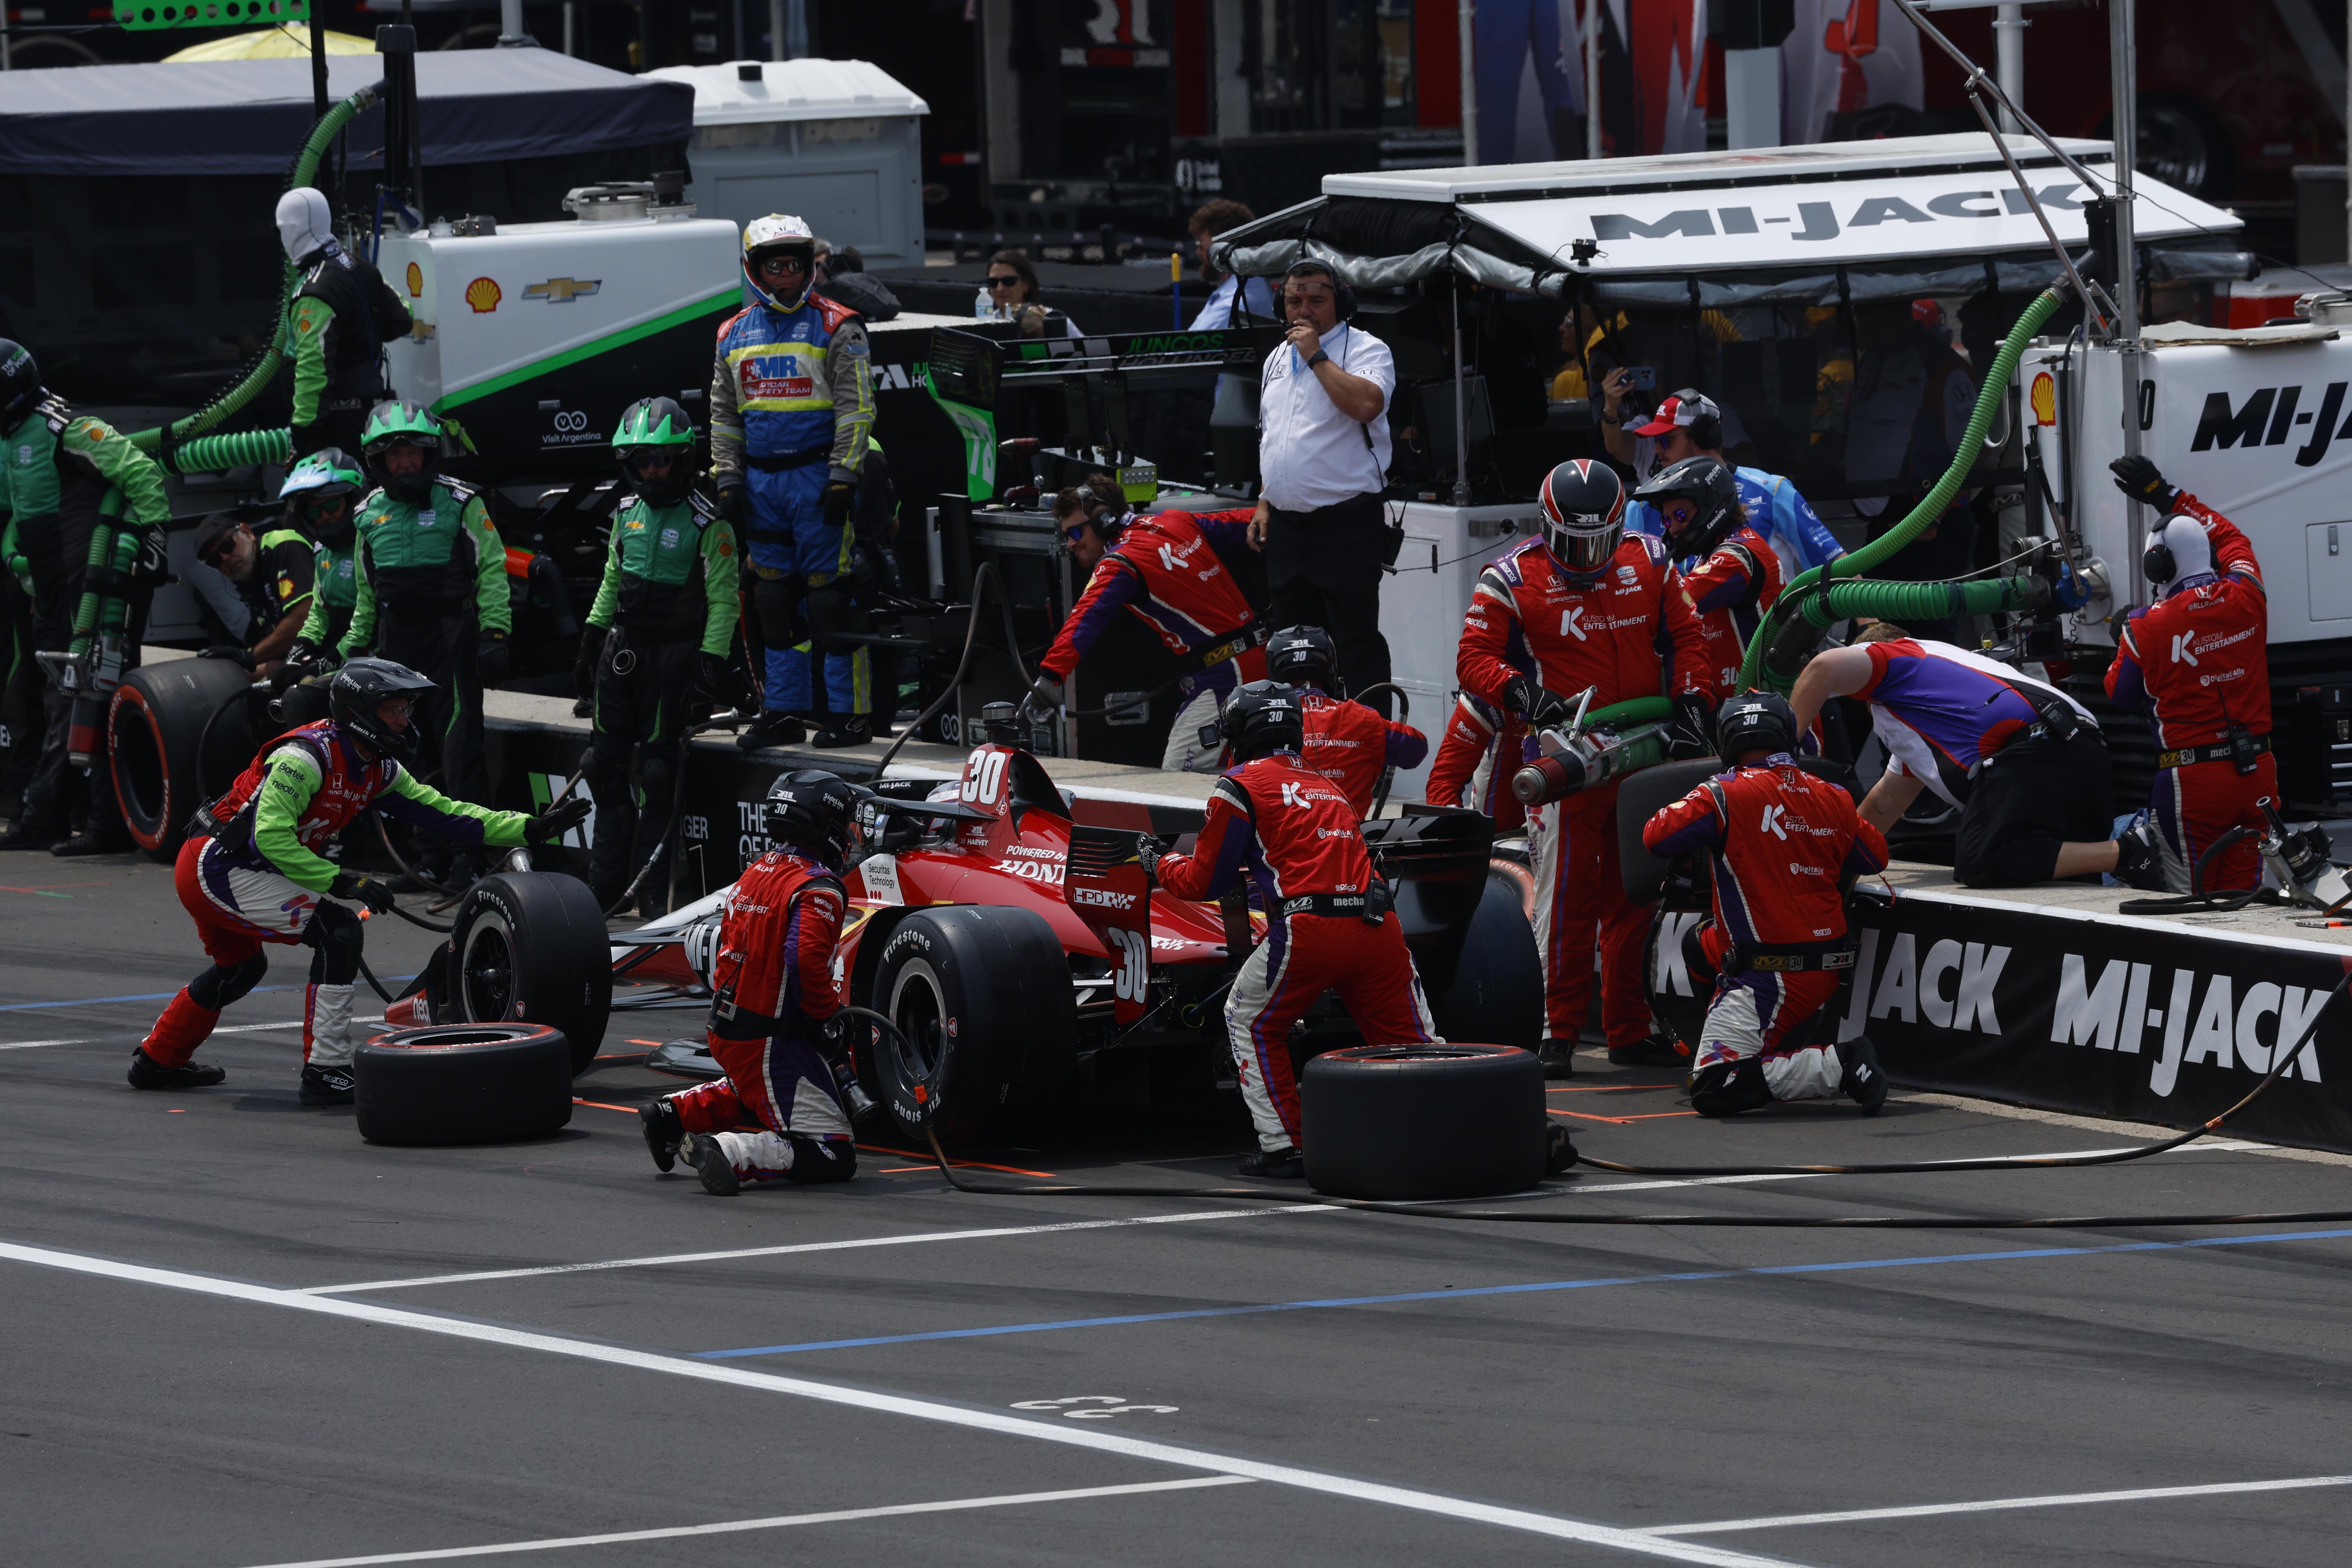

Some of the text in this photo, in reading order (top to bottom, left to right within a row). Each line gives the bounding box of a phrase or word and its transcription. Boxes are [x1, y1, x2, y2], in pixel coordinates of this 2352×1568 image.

[1590, 183, 2086, 241] MI-JACK
[1125, 334, 1224, 354] JUNCOS
[741, 356, 799, 382] AMR
[542, 434, 560, 444] Visit
[1704, 465, 1721, 483] SideLine
[1706, 508, 1727, 530] Connelly
[1499, 562, 1517, 582] sparco
[1615, 585, 1642, 595] MI-JACK
[1552, 595, 1583, 603] peopleready
[2188, 597, 2225, 611] @RLLRacing
[1469, 603, 1486, 613] ortek
[1584, 615, 1647, 630] ENTERTINMENT
[2193, 632, 2223, 647] KUSTOM
[2195, 627, 2256, 655] ENTERTAINMENT
[1293, 651, 1307, 662] 30
[341, 673, 361, 690] SideLine
[1721, 666, 1738, 686] 30
[1268, 711, 1283, 722] 30
[1488, 706, 1502, 728] sparco
[1743, 714, 1758, 725] 30
[350, 722, 369, 736] Semik
[1457, 720, 1477, 740] Bortek
[1303, 739, 1360, 748] NTERTAINMENT
[319, 743, 331, 769] sparco
[2182, 750, 2193, 762] 30
[278, 762, 306, 782] Bortek
[962, 750, 1006, 804] 30
[879, 781, 911, 789] MI-JACK
[774, 803, 788, 815] 30
[824, 793, 845, 809] SideLine
[737, 801, 768, 833] THE
[1006, 845, 1067, 862] POWERED by
[868, 864, 890, 875] Securitas
[1491, 860, 1525, 876] stone
[869, 875, 895, 889] Technology
[477, 890, 515, 932] Firestone
[814, 896, 834, 911] Bortek
[1813, 927, 1832, 936] sparco
[884, 928, 931, 963] Firestone
[1108, 927, 1147, 1004] 30
[1791, 955, 1802, 969] 30
[1838, 927, 2012, 1044] JACK
[2051, 953, 2334, 1098] MI-JACK
[323, 1074, 349, 1087] sparco
